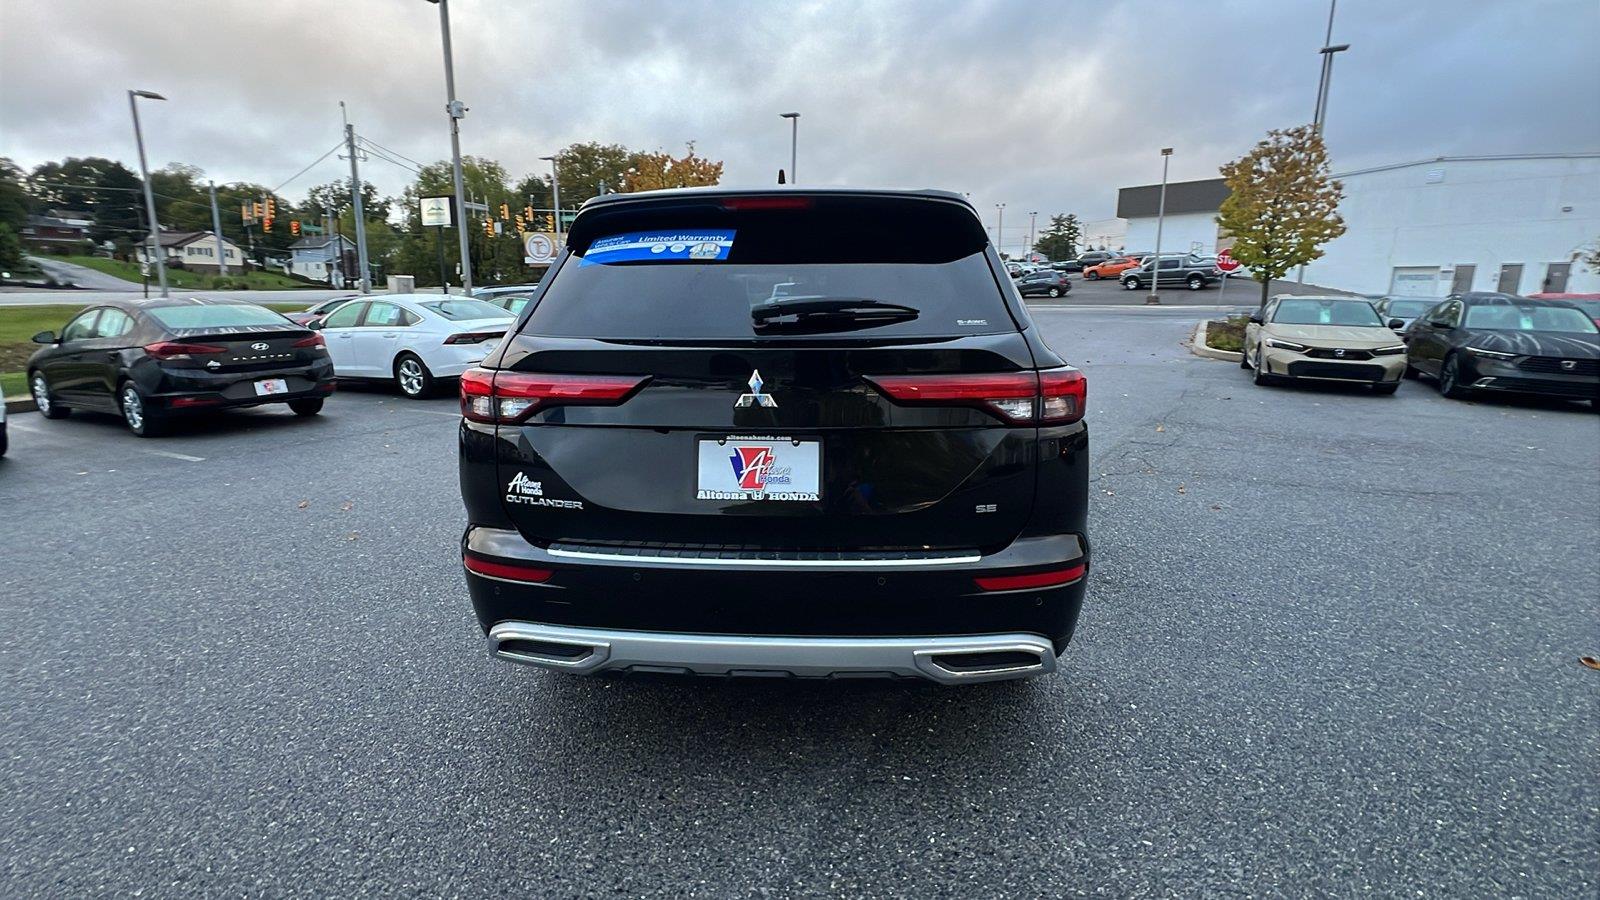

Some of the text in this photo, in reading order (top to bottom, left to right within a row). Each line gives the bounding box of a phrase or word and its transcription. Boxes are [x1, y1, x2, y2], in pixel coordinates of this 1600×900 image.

[760, 475, 790, 483] Honda
[521, 487, 543, 495] Honda
[697, 490, 820, 501] Altoona HONDA
[505, 494, 584, 510] OUTLANDER
[975, 504, 997, 513] SE
